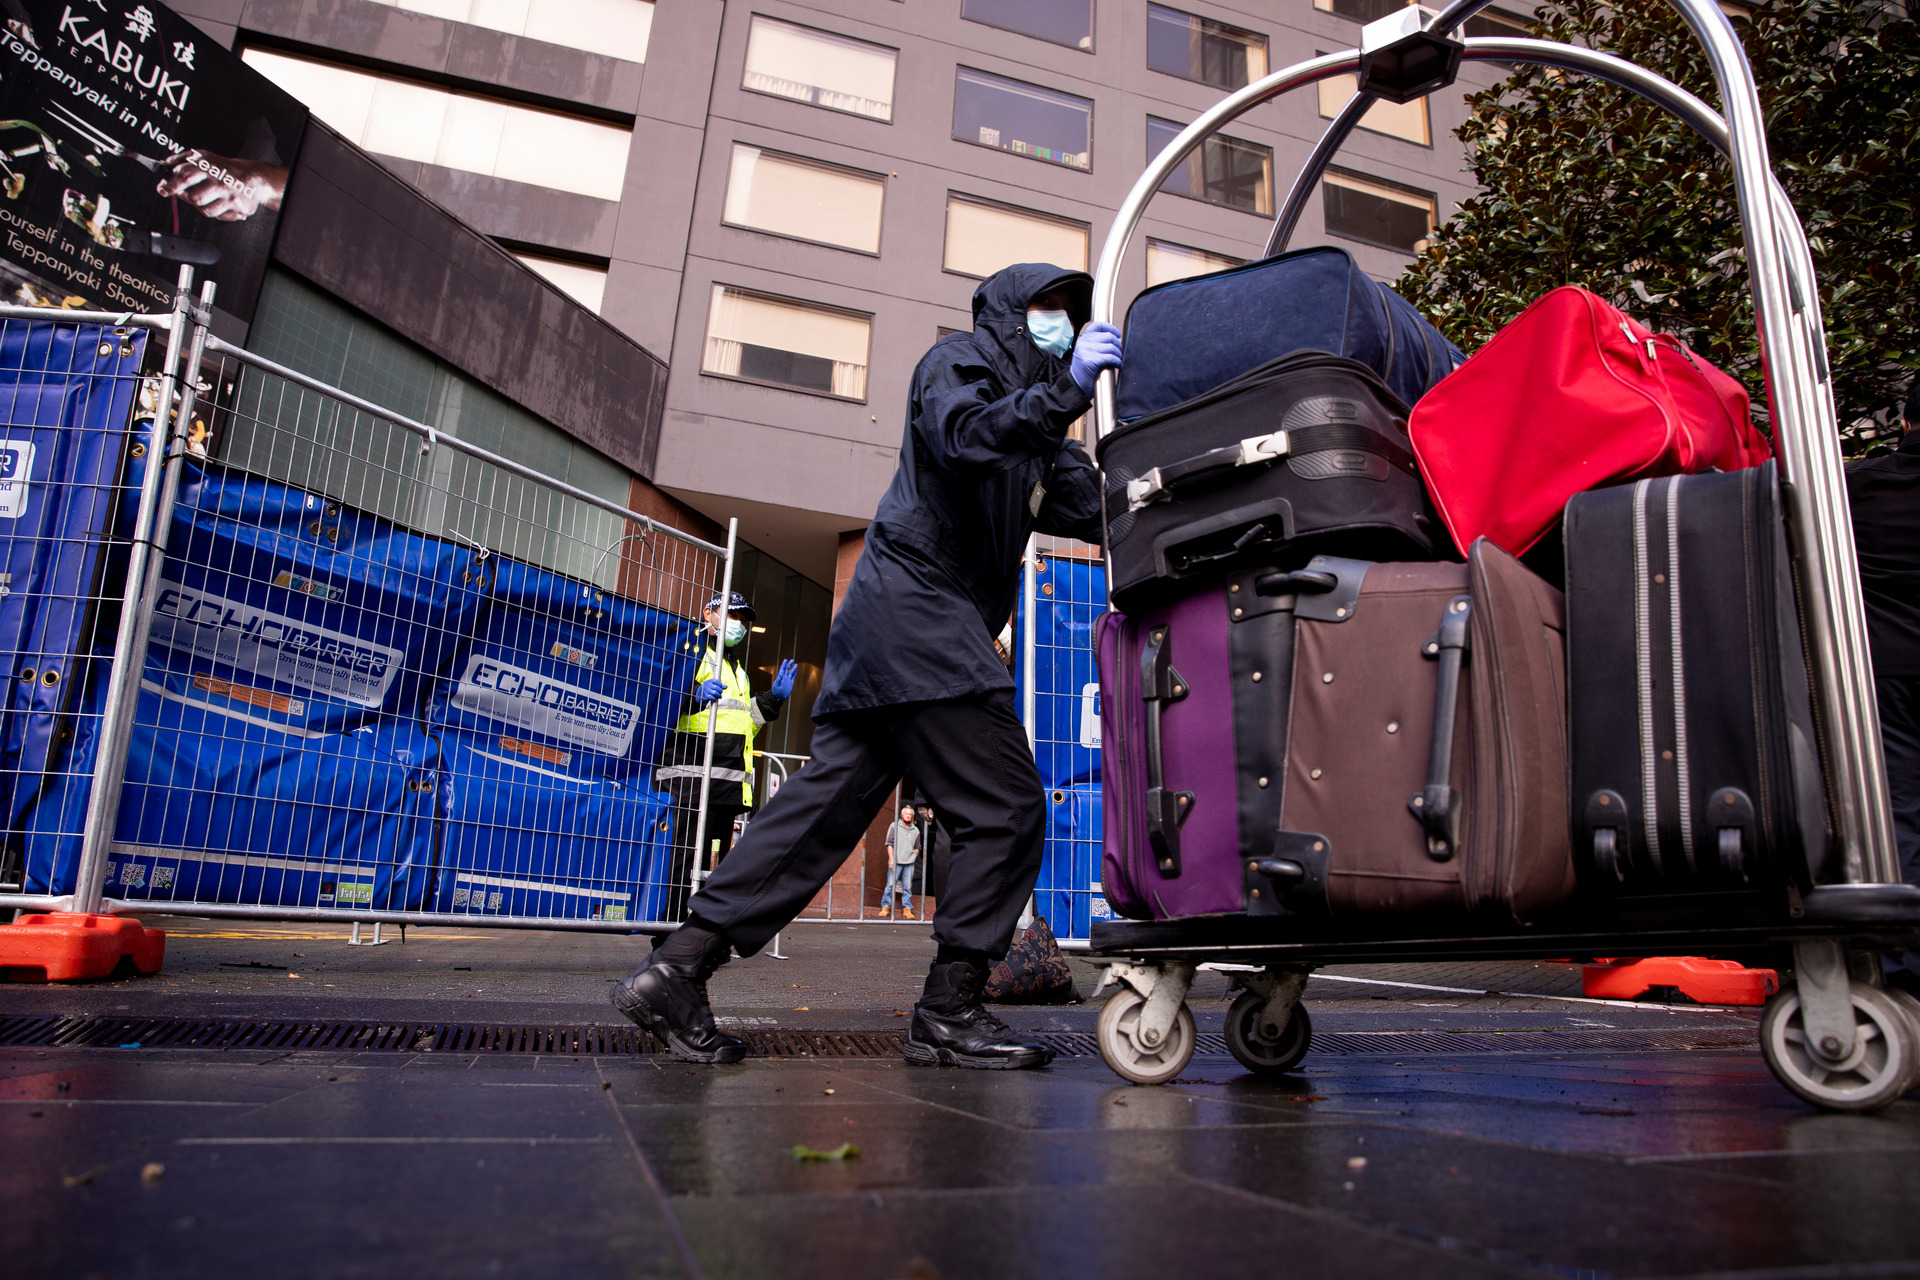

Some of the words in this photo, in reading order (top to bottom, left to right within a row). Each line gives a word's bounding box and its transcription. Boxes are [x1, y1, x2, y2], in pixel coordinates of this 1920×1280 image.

[56, 36, 181, 124] TEPPANYAKI
[58, 5, 190, 111] KABUKI
[1, 28, 119, 114] Teppanyaki
[118, 107, 139, 128] in
[141, 121, 185, 154] New
[186, 148, 258, 199] Zealand
[980, 127, 999, 137] DAY
[0, 206, 58, 245] ourself
[60, 237, 75, 256] in
[80, 247, 105, 270] the
[109, 262, 170, 304] theatrics
[7, 229, 102, 291] Teppanyaki
[105, 282, 150, 314] Show
[159, 633, 240, 663] info@echobarrer.com
[197, 678, 230, 692] WANING
[351, 673, 380, 688] Sound
[555, 712, 606, 735] Environmentlly
[606, 728, 626, 740] Soud
